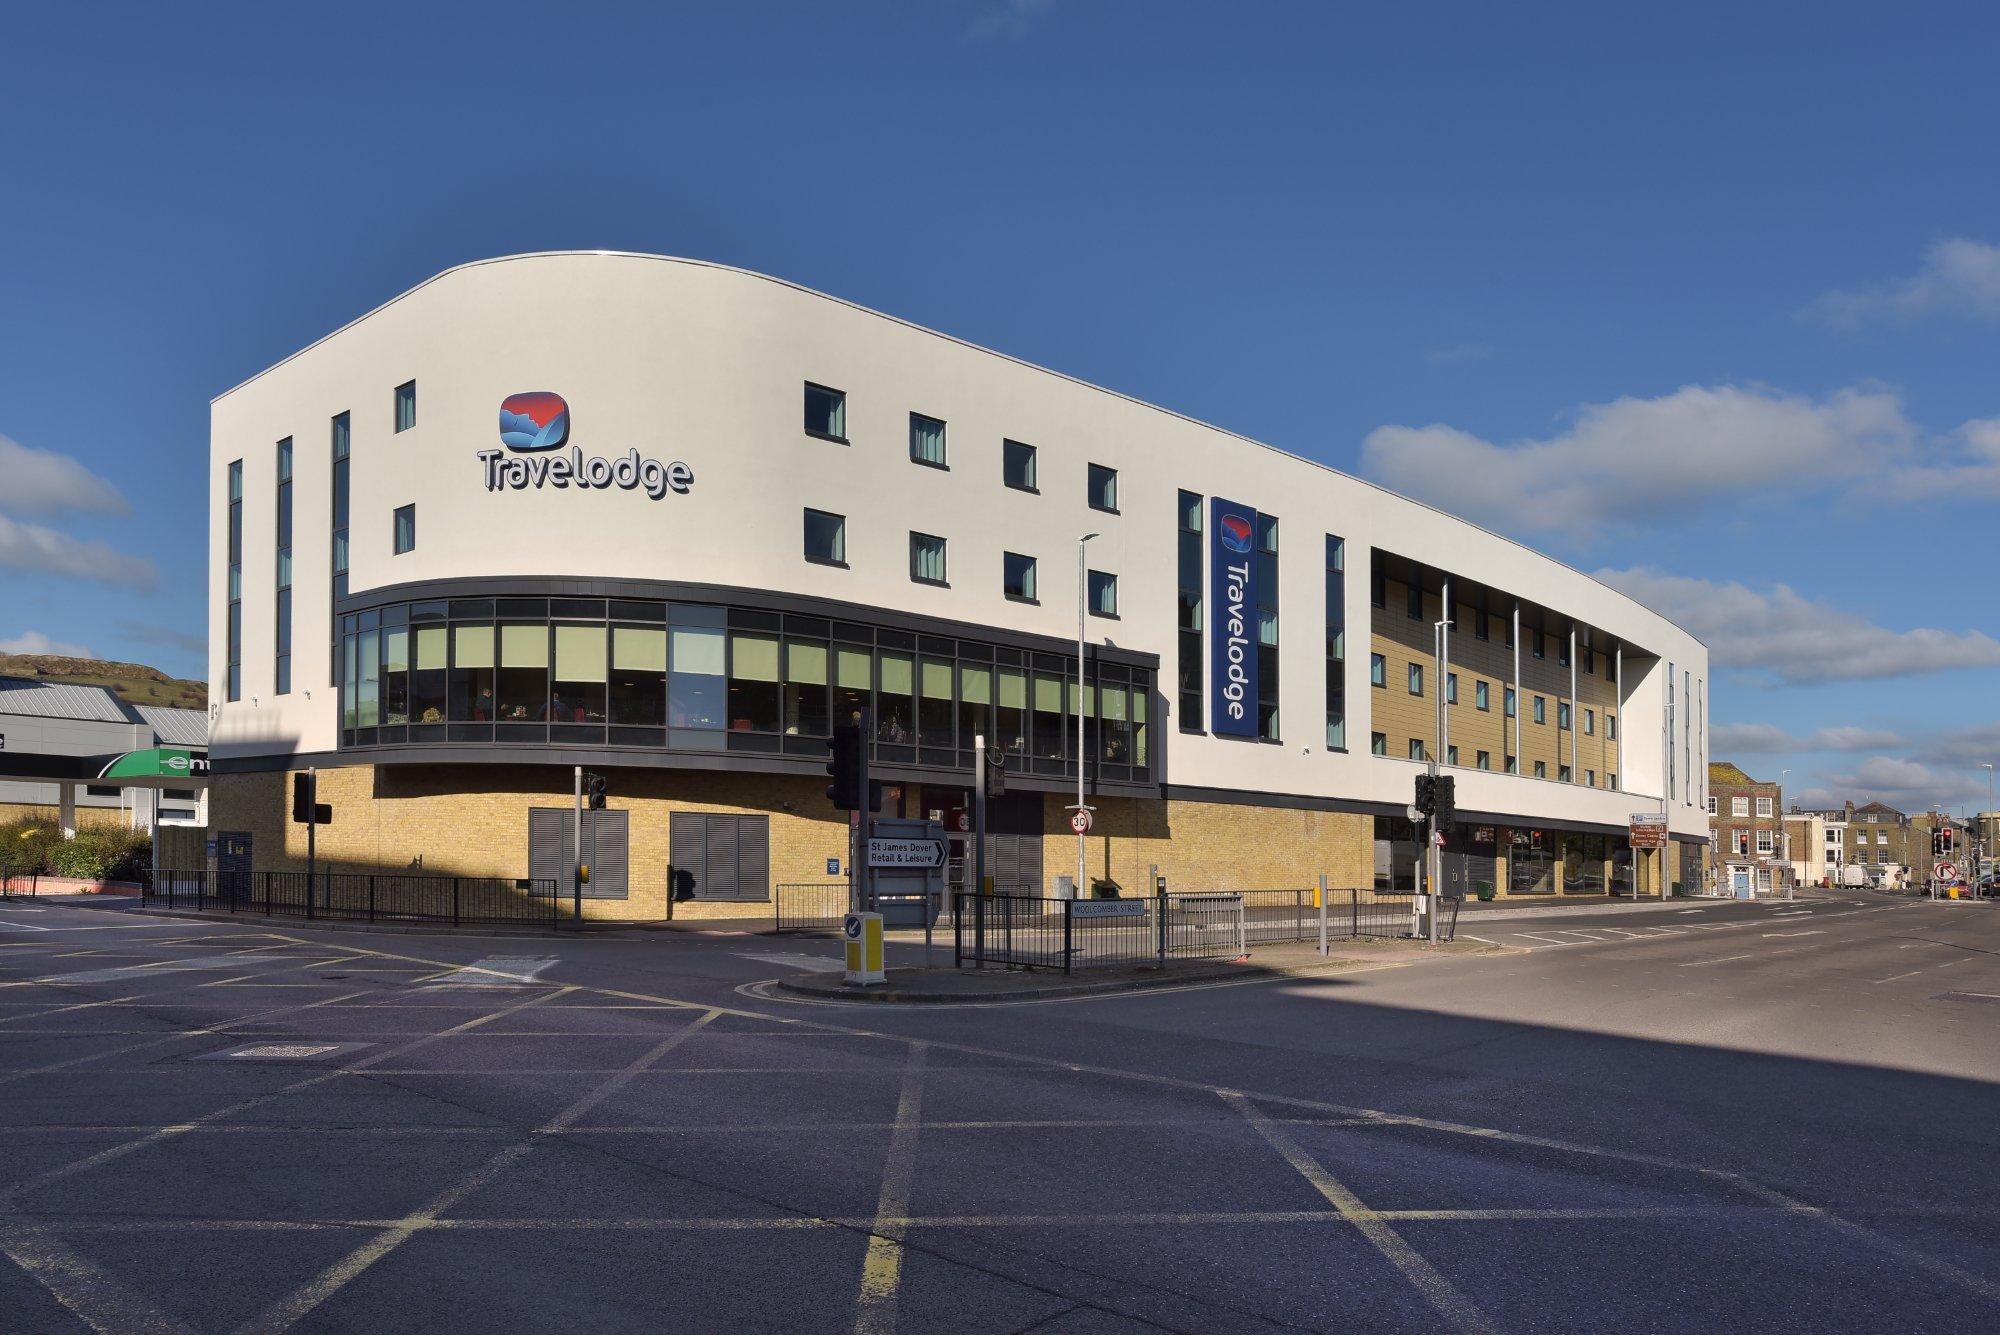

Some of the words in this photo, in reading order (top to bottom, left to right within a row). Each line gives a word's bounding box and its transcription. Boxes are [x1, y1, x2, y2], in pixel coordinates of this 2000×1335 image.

[477, 446, 693, 500] Travelodge
[1223, 562, 1249, 720] Travelodge
[1074, 817, 1085, 826] 30
[871, 842, 881, 851] St
[883, 842, 908, 852] James
[910, 843, 932, 852] Dover
[871, 853, 895, 862] Retail
[897, 853, 902, 862] &
[905, 853, 932, 863] Leisure
[1074, 904, 1118, 914] WOOLCOMBER
[1120, 904, 1143, 912] STREET
